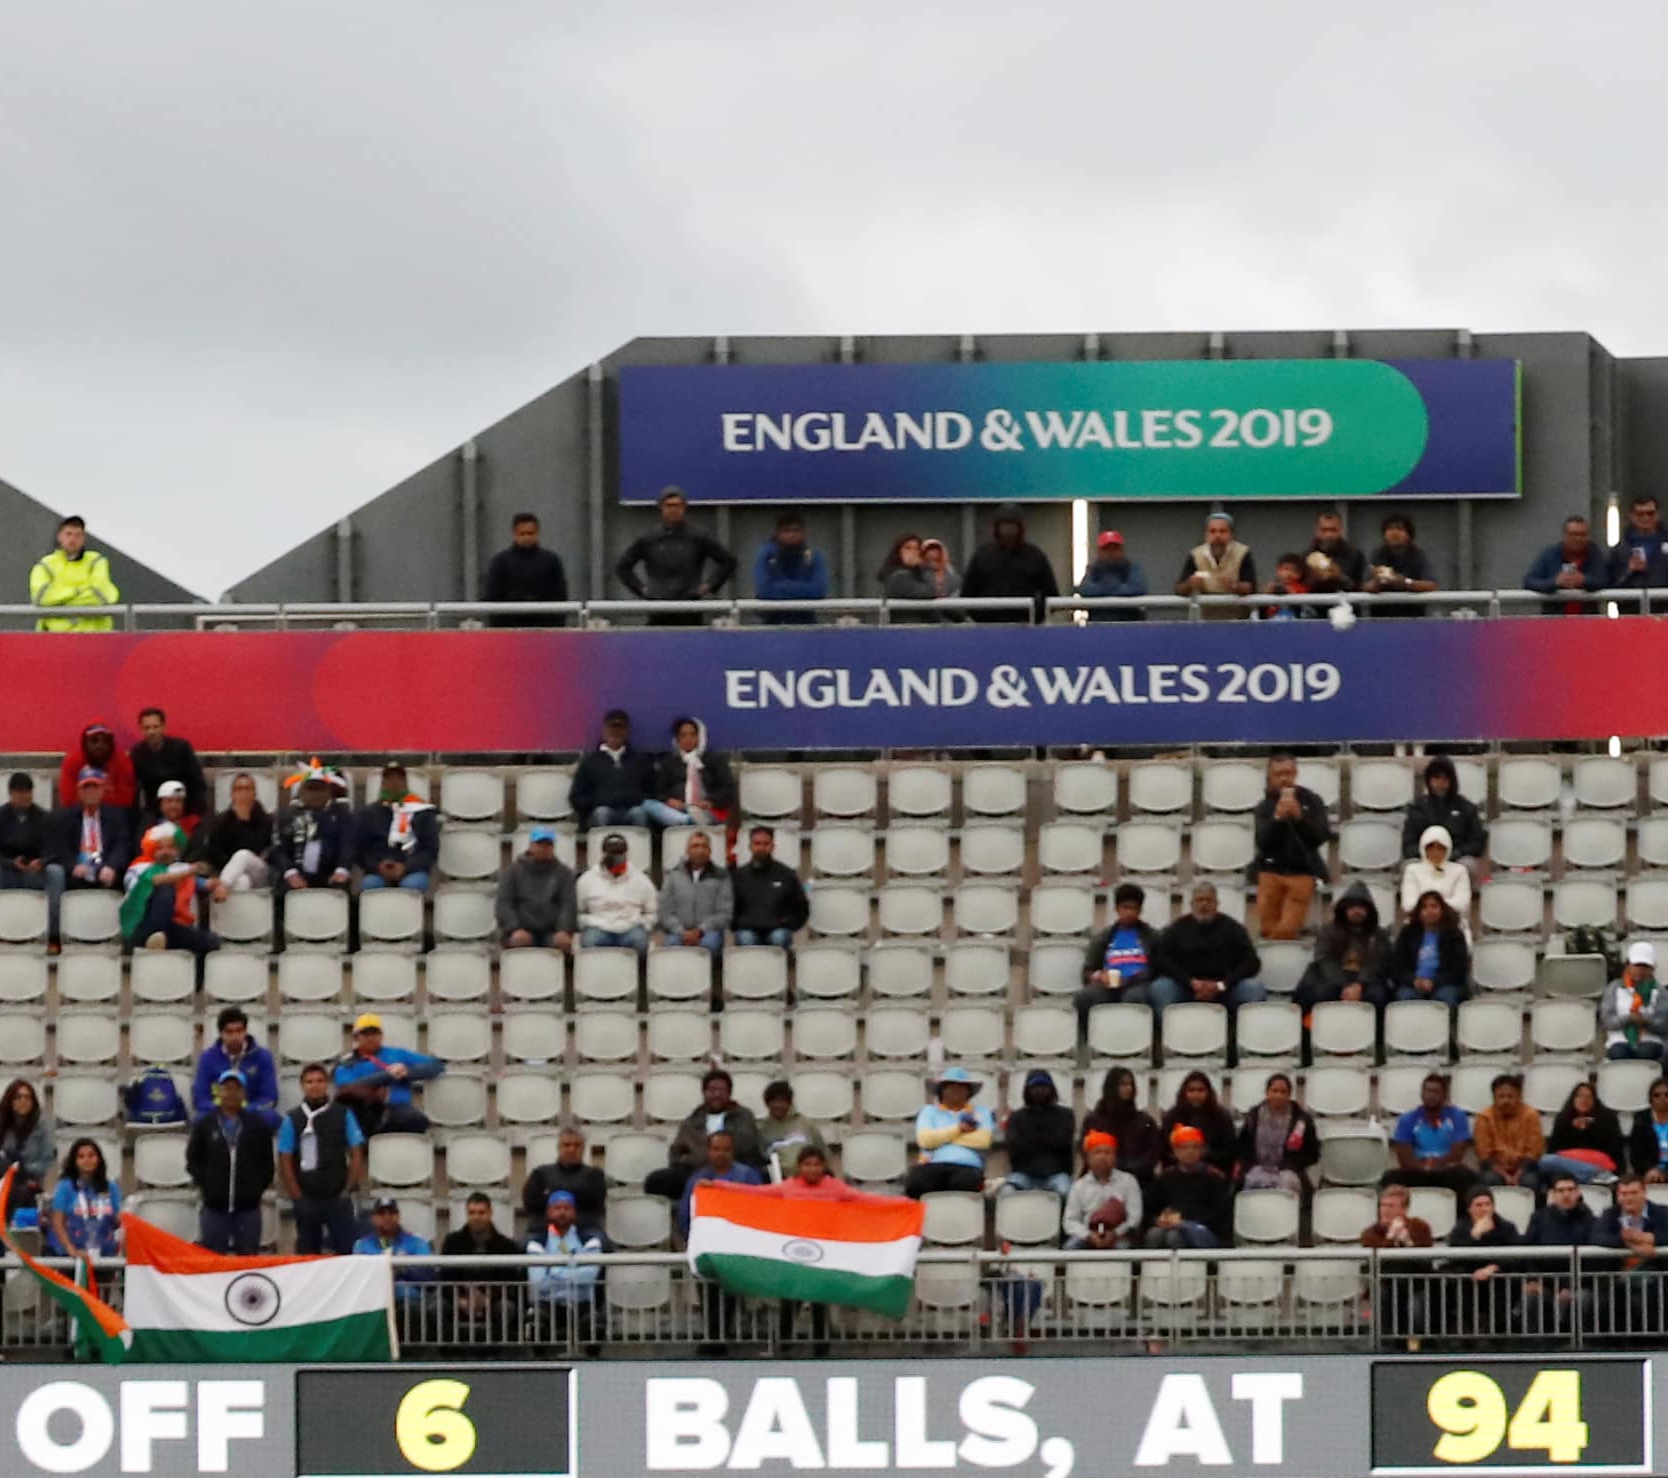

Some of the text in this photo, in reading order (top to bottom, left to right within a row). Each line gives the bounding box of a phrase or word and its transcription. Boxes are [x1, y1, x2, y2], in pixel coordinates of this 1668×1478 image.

[723, 410, 972, 453] ENGLAND
[1024, 409, 1203, 450] WALES
[1209, 408, 1334, 448] 2019
[726, 666, 979, 709] ENGLAND
[1030, 663, 1210, 705] WALES
[1216, 662, 1341, 703] 2019
[16, 1380, 265, 1474] OFF
[394, 1378, 477, 1473] 6
[1134, 1372, 1303, 1467] AT
[1426, 1369, 1589, 1465] 94
